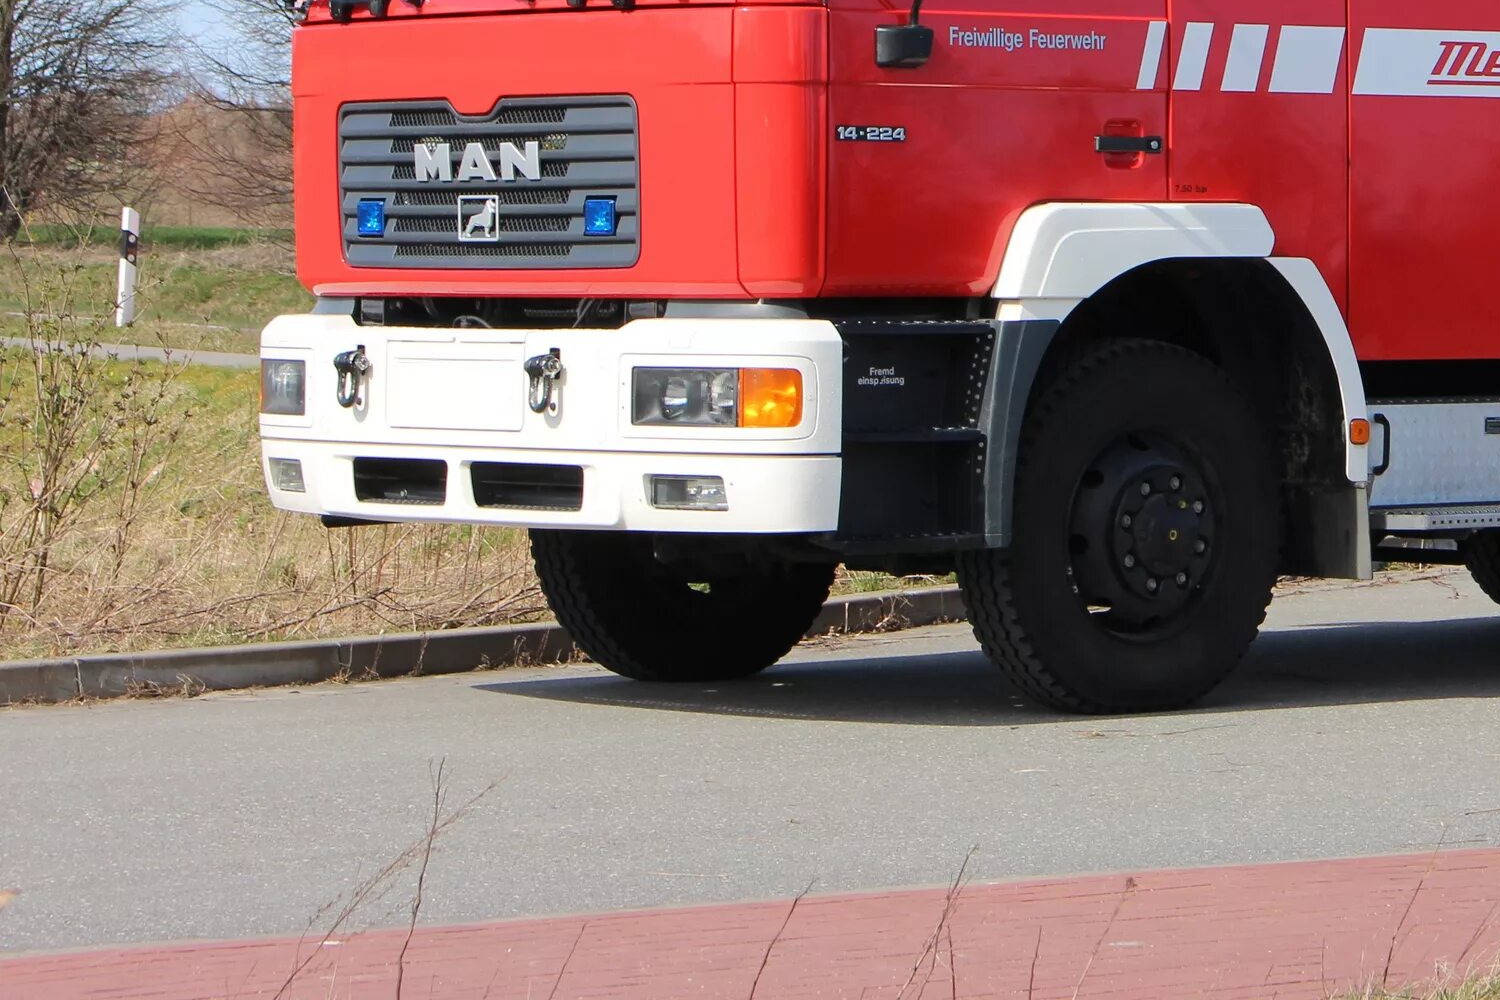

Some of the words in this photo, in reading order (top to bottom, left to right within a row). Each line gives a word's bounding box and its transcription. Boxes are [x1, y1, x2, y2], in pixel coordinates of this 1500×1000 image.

[949, 26, 1024, 52] Freiwillige
[1029, 29, 1107, 51] Feuerwehr
[414, 141, 541, 182] MAN
[869, 366, 895, 376] Fremd
